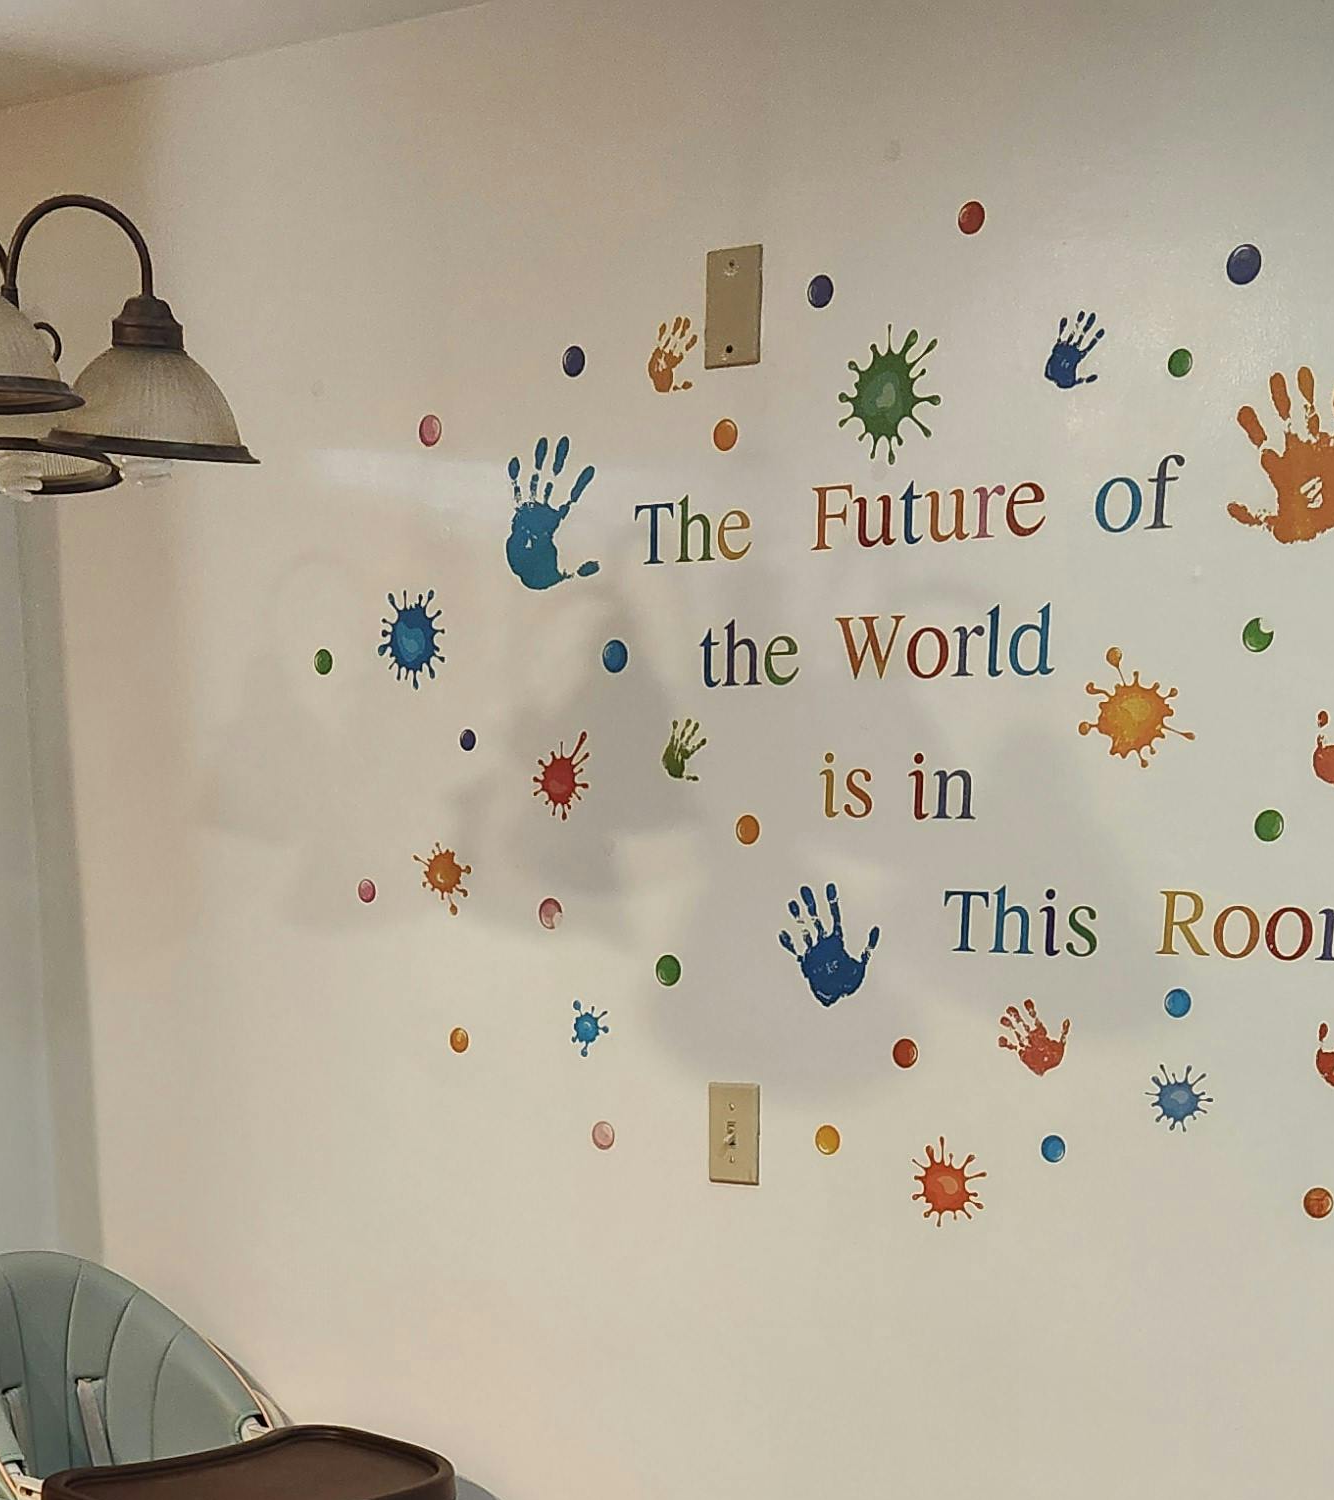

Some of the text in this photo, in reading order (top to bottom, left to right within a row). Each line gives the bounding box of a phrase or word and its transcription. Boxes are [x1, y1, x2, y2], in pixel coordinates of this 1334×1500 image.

[635, 455, 1185, 564] The Future of
[700, 602, 1055, 687] the World
[820, 753, 975, 820] is in
[944, 885, 1097, 957] This
